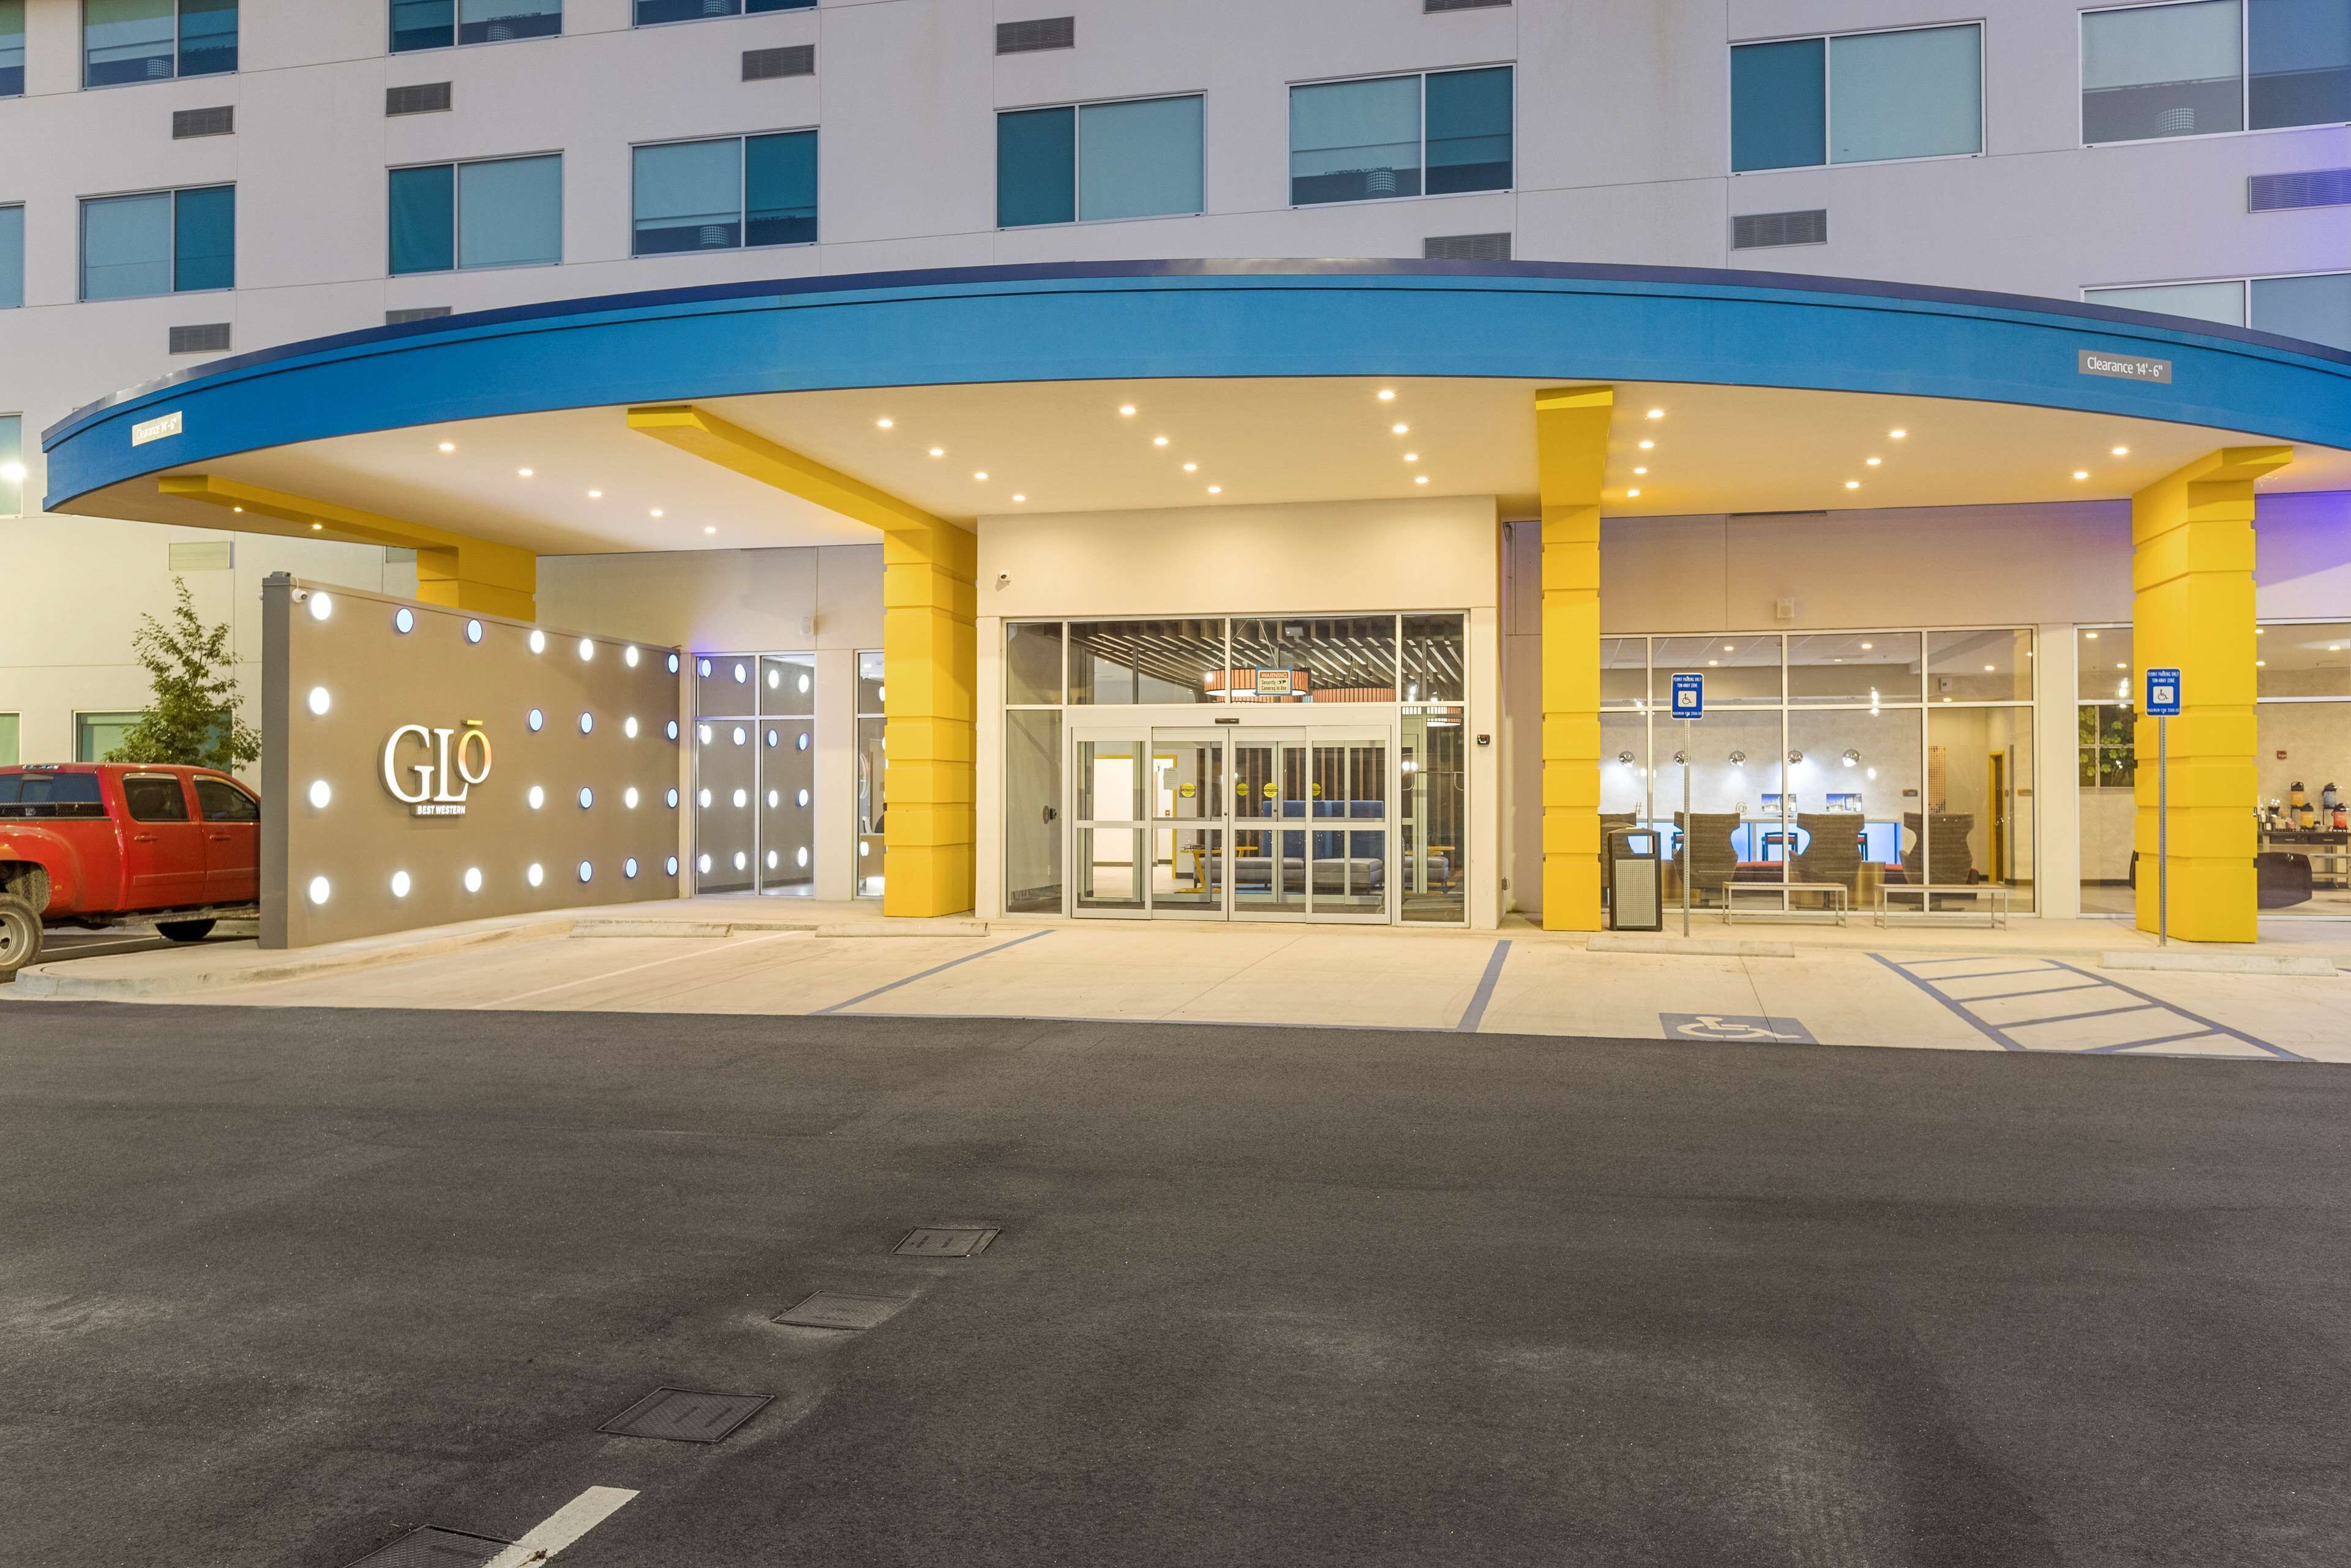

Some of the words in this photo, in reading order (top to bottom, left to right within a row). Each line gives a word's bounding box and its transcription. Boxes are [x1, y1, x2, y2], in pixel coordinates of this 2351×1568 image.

[2087, 356, 2134, 374] Clearance
[418, 805, 435, 814] BEST
[435, 805, 465, 814] WESTERN
